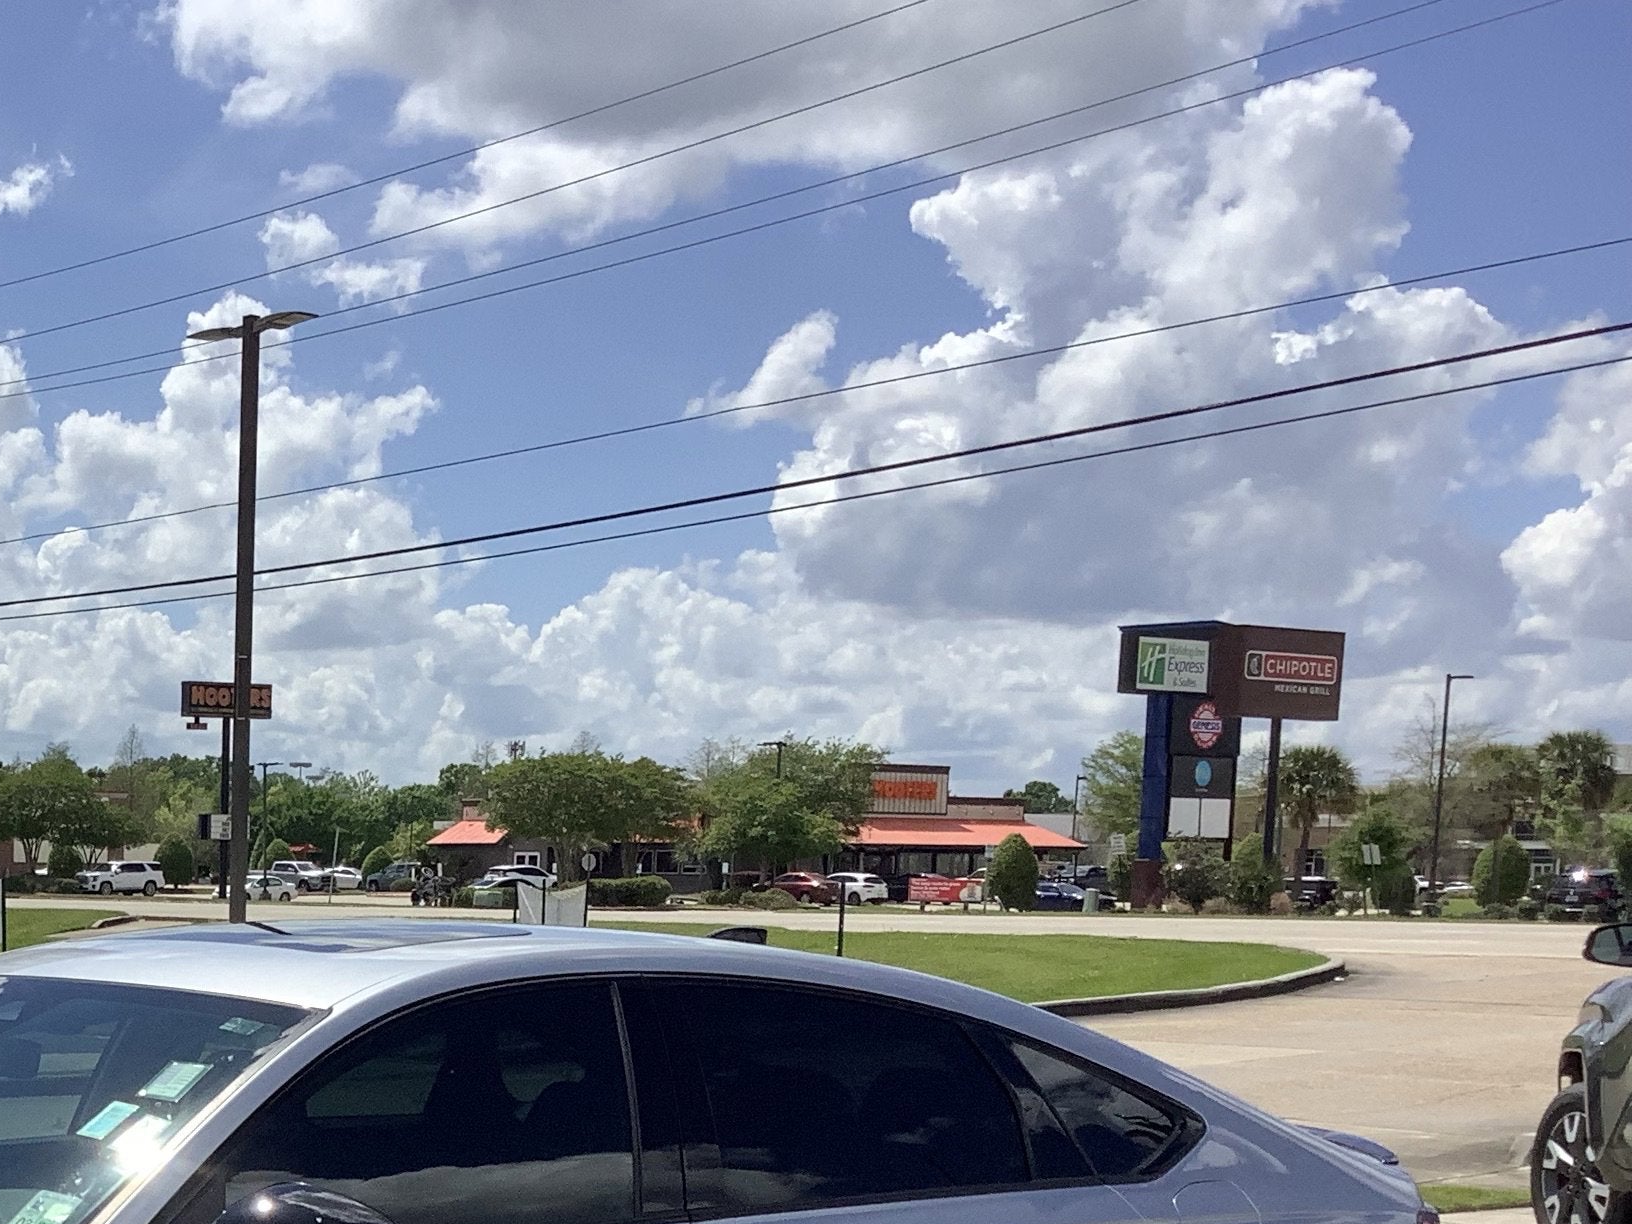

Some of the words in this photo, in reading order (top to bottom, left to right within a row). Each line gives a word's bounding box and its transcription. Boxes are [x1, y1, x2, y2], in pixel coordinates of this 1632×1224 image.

[1168, 656, 1205, 675] Express
[1267, 659, 1333, 677] CHIPOTLE
[191, 685, 271, 707] HOORS
[1274, 684, 1308, 694] MEXICAN
[1309, 686, 1330, 695] GRILL
